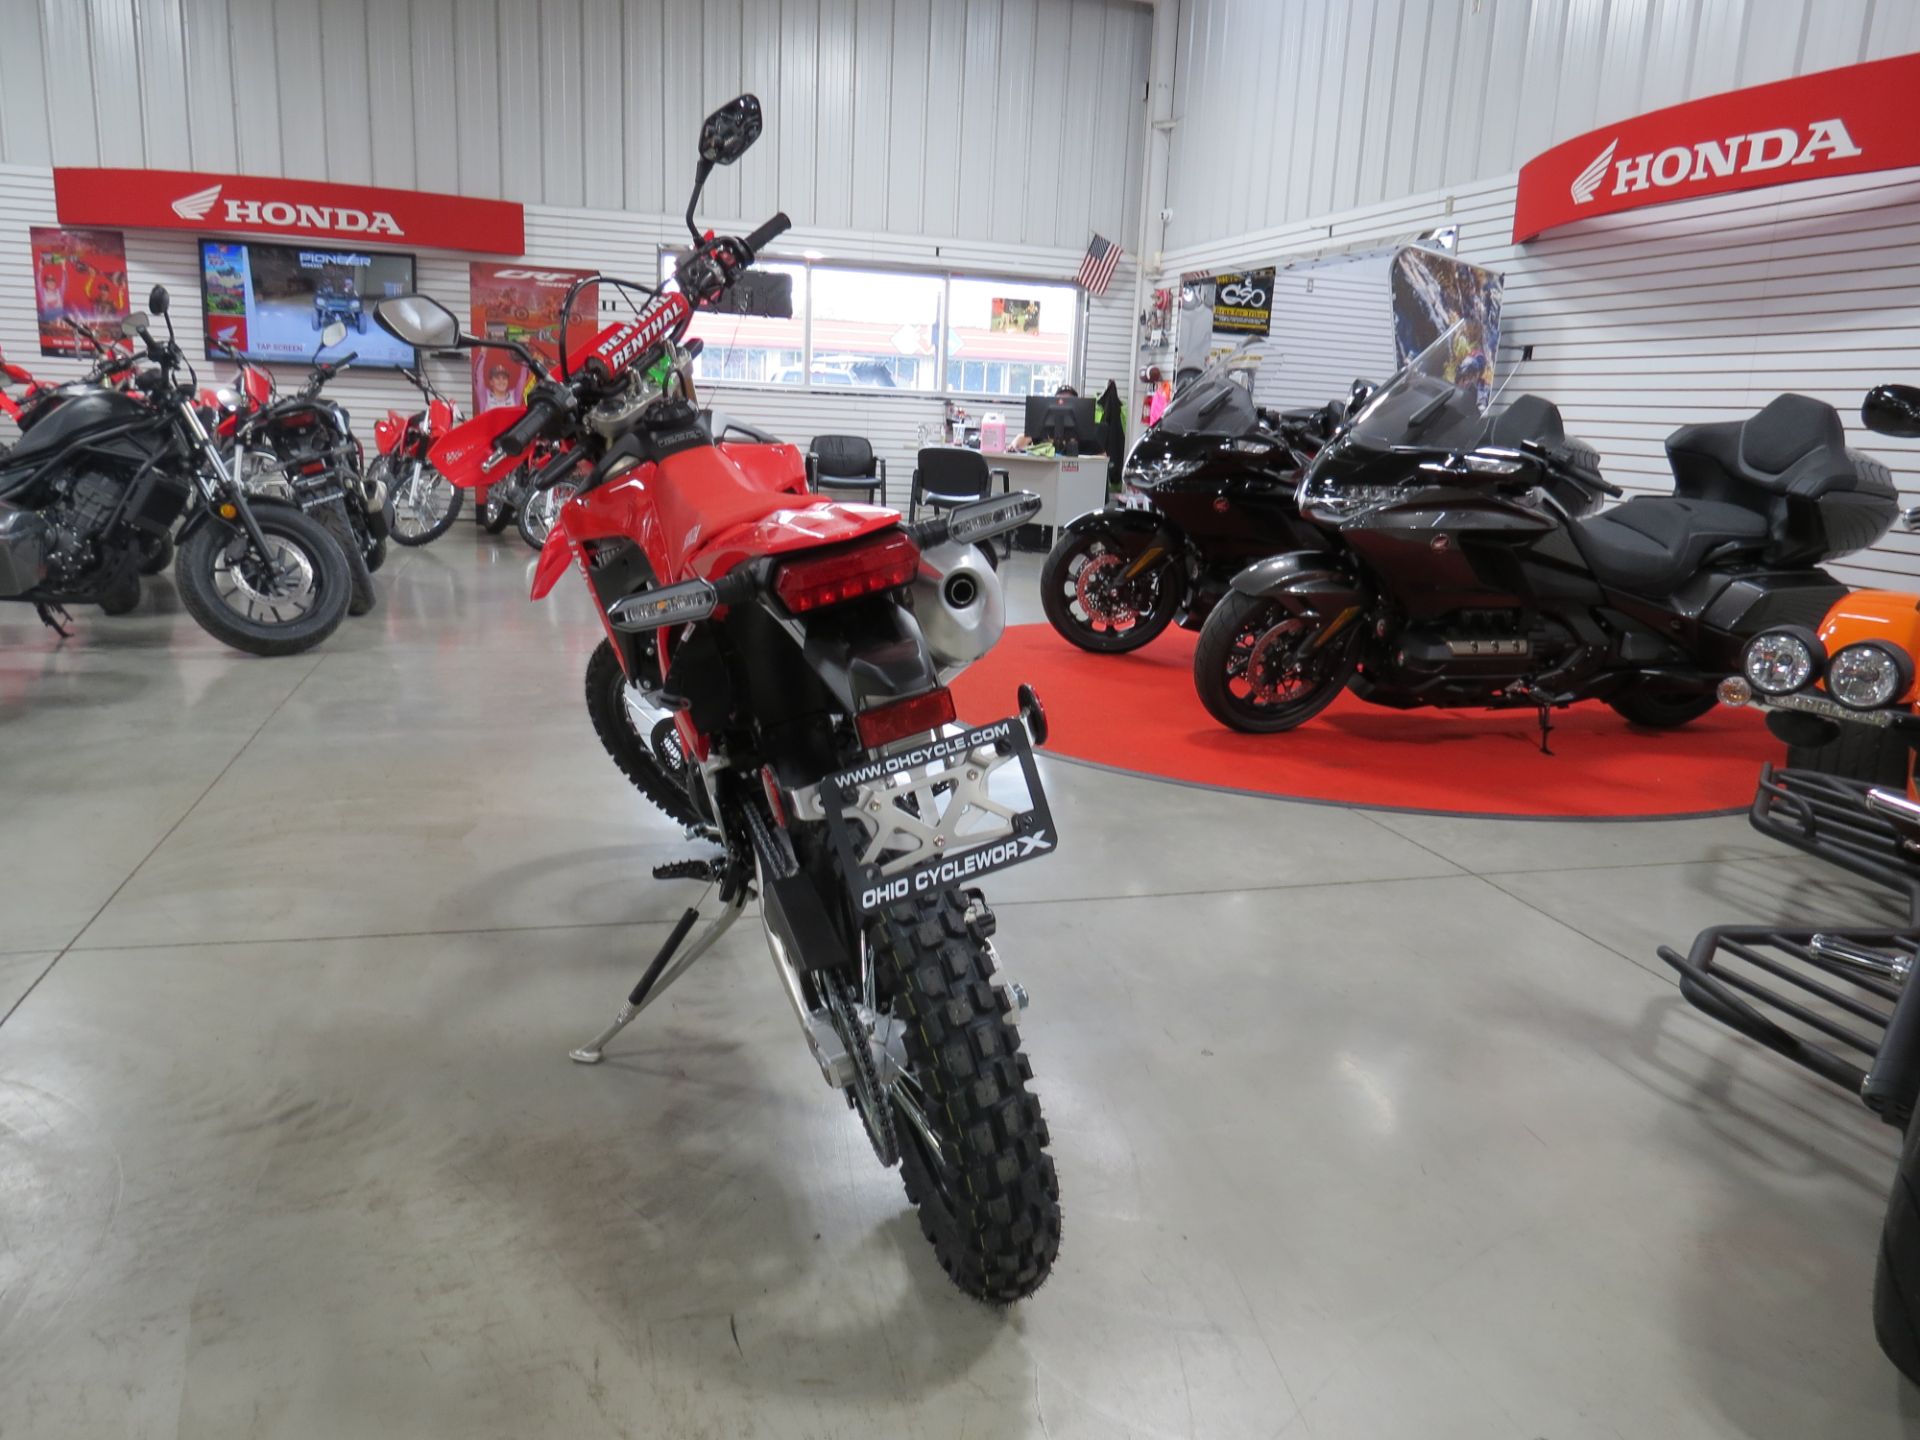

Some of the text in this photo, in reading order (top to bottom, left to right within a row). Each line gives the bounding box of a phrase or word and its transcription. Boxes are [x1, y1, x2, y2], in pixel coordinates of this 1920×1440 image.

[1611, 118, 1863, 196] HONDA
[223, 199, 405, 236] HONDA
[299, 252, 372, 267] PIONEER
[493, 269, 577, 281] CRF
[272, 343, 303, 352] SCREEN
[597, 293, 673, 355] RENTHAL
[612, 302, 684, 370] RENTHAL
[835, 723, 1010, 788] WWW.OHCYCLE.COM
[862, 829, 1052, 909] OHIO CYCLEWORX
